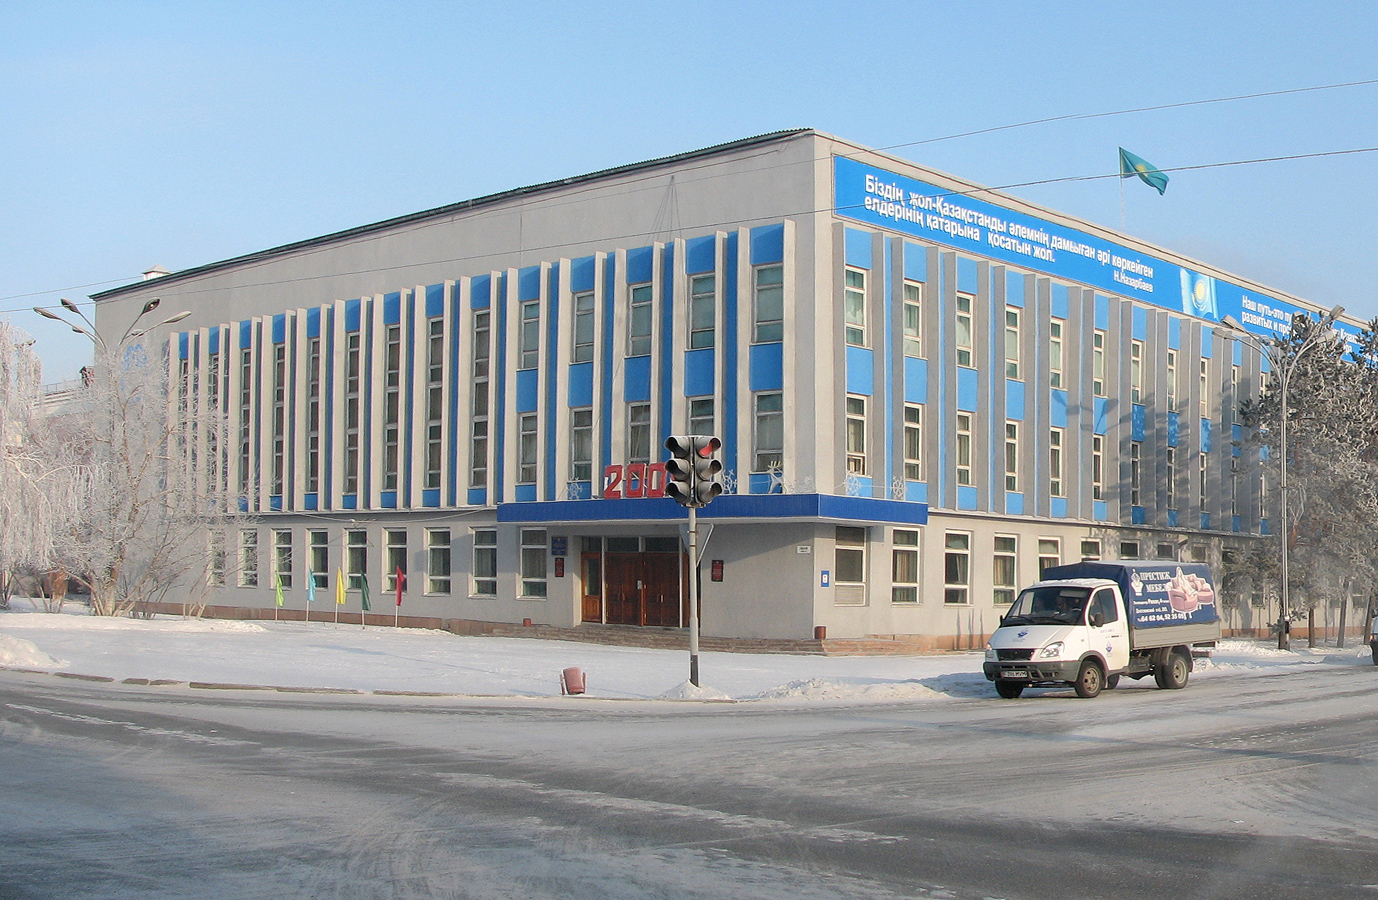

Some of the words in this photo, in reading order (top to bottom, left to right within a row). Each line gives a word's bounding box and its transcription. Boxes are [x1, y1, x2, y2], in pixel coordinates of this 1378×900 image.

[864, 196, 924, 228] елдерінің
[926, 214, 981, 242] қатарына
[987, 231, 1031, 256] қосатын
[865, 174, 905, 206] Біздің
[1008, 222, 1050, 248] әлемнің
[1097, 249, 1111, 266] әрі
[1111, 254, 1154, 279] көркейген
[1242, 295, 1257, 312] Наш
[1241, 311, 1273, 330] развитых
[1139, 571, 1171, 581] ПРЕСТИЖ
